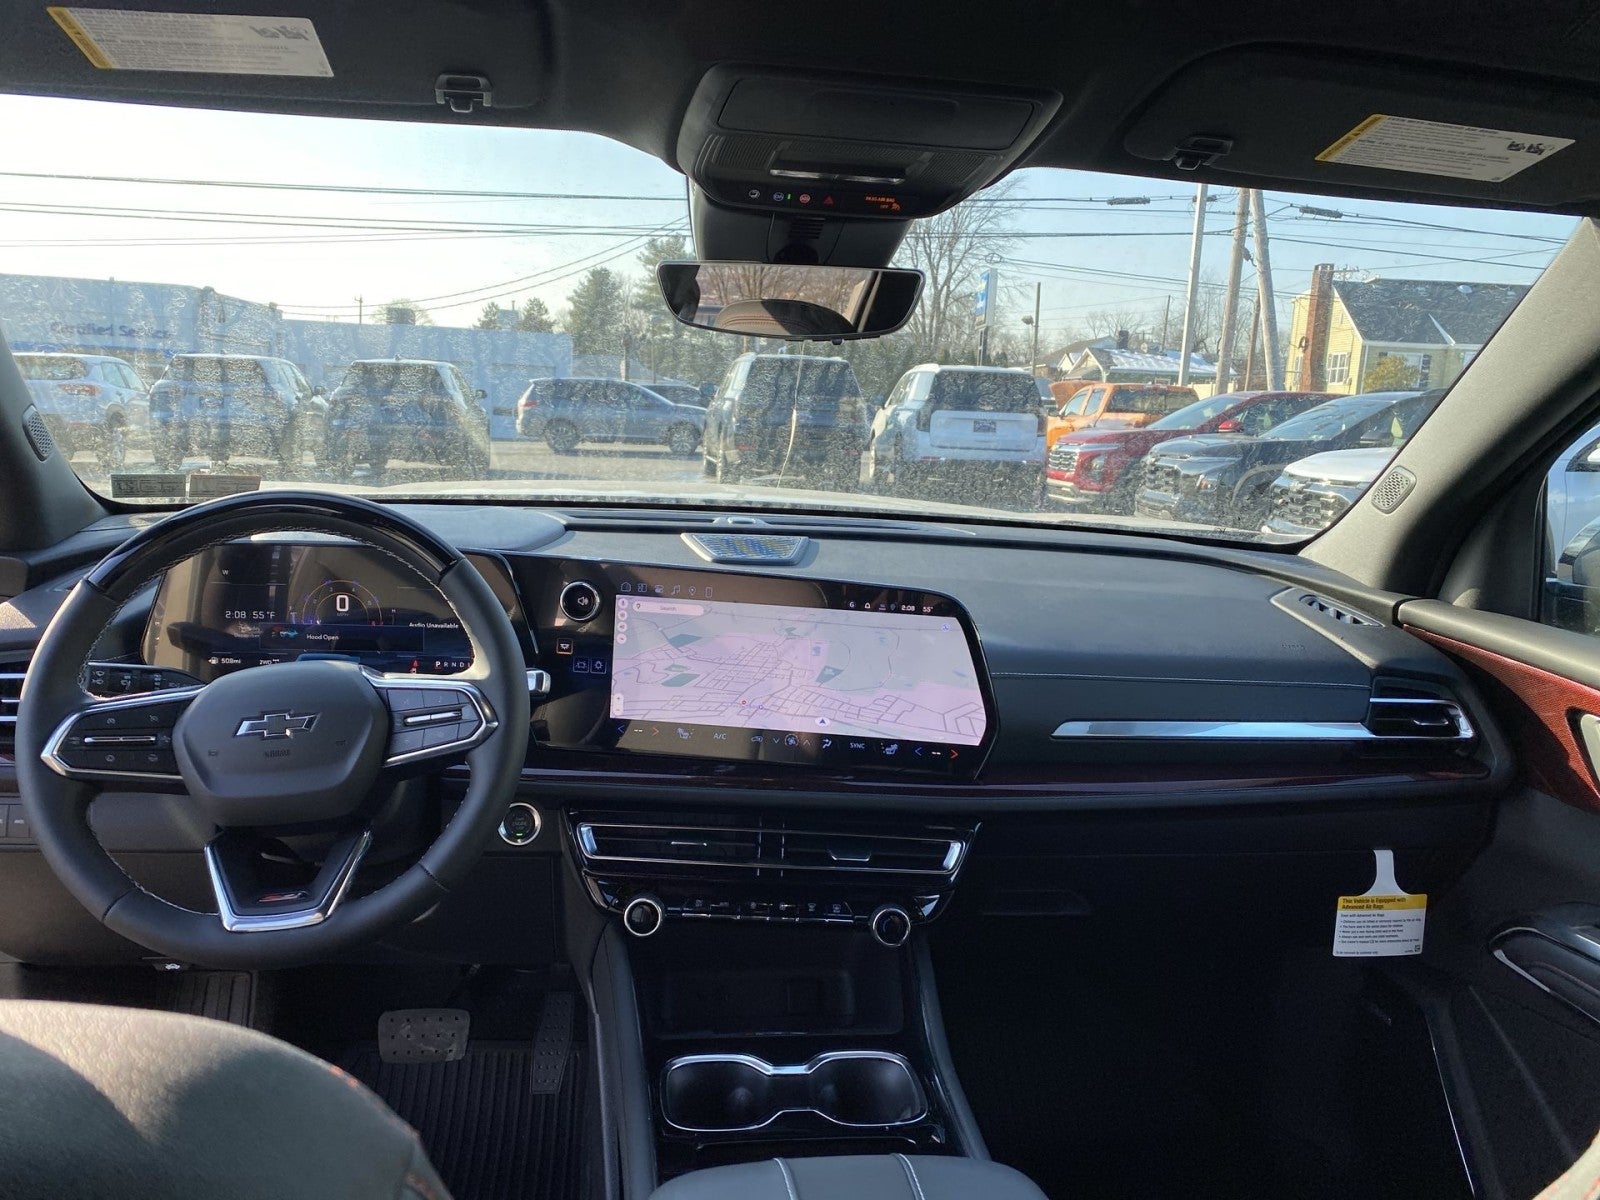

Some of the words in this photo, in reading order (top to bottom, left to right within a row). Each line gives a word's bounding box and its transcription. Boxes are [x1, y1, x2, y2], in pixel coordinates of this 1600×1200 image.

[336, 594, 349, 612] 0
[225, 610, 247, 619] 2:08
[323, 633, 340, 641] Open
[713, 732, 727, 740] A/C
